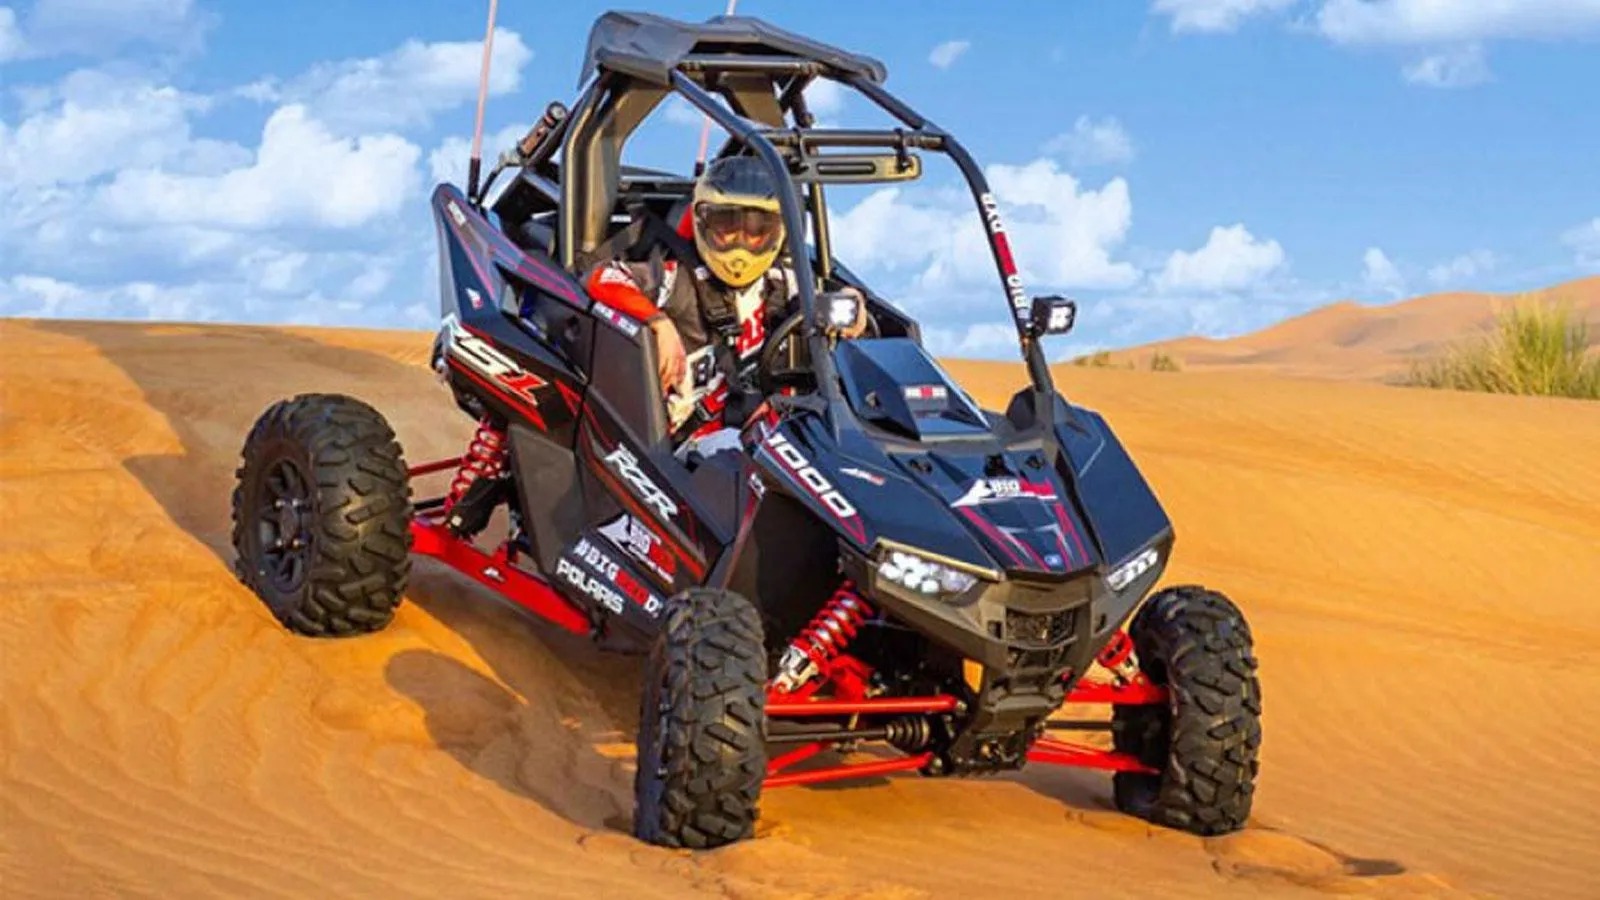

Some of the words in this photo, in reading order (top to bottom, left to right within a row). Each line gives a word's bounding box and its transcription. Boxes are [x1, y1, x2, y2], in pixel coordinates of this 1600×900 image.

[604, 443, 678, 521] RZR
[759, 421, 857, 518] 1000
[556, 557, 624, 614] POLARIS
